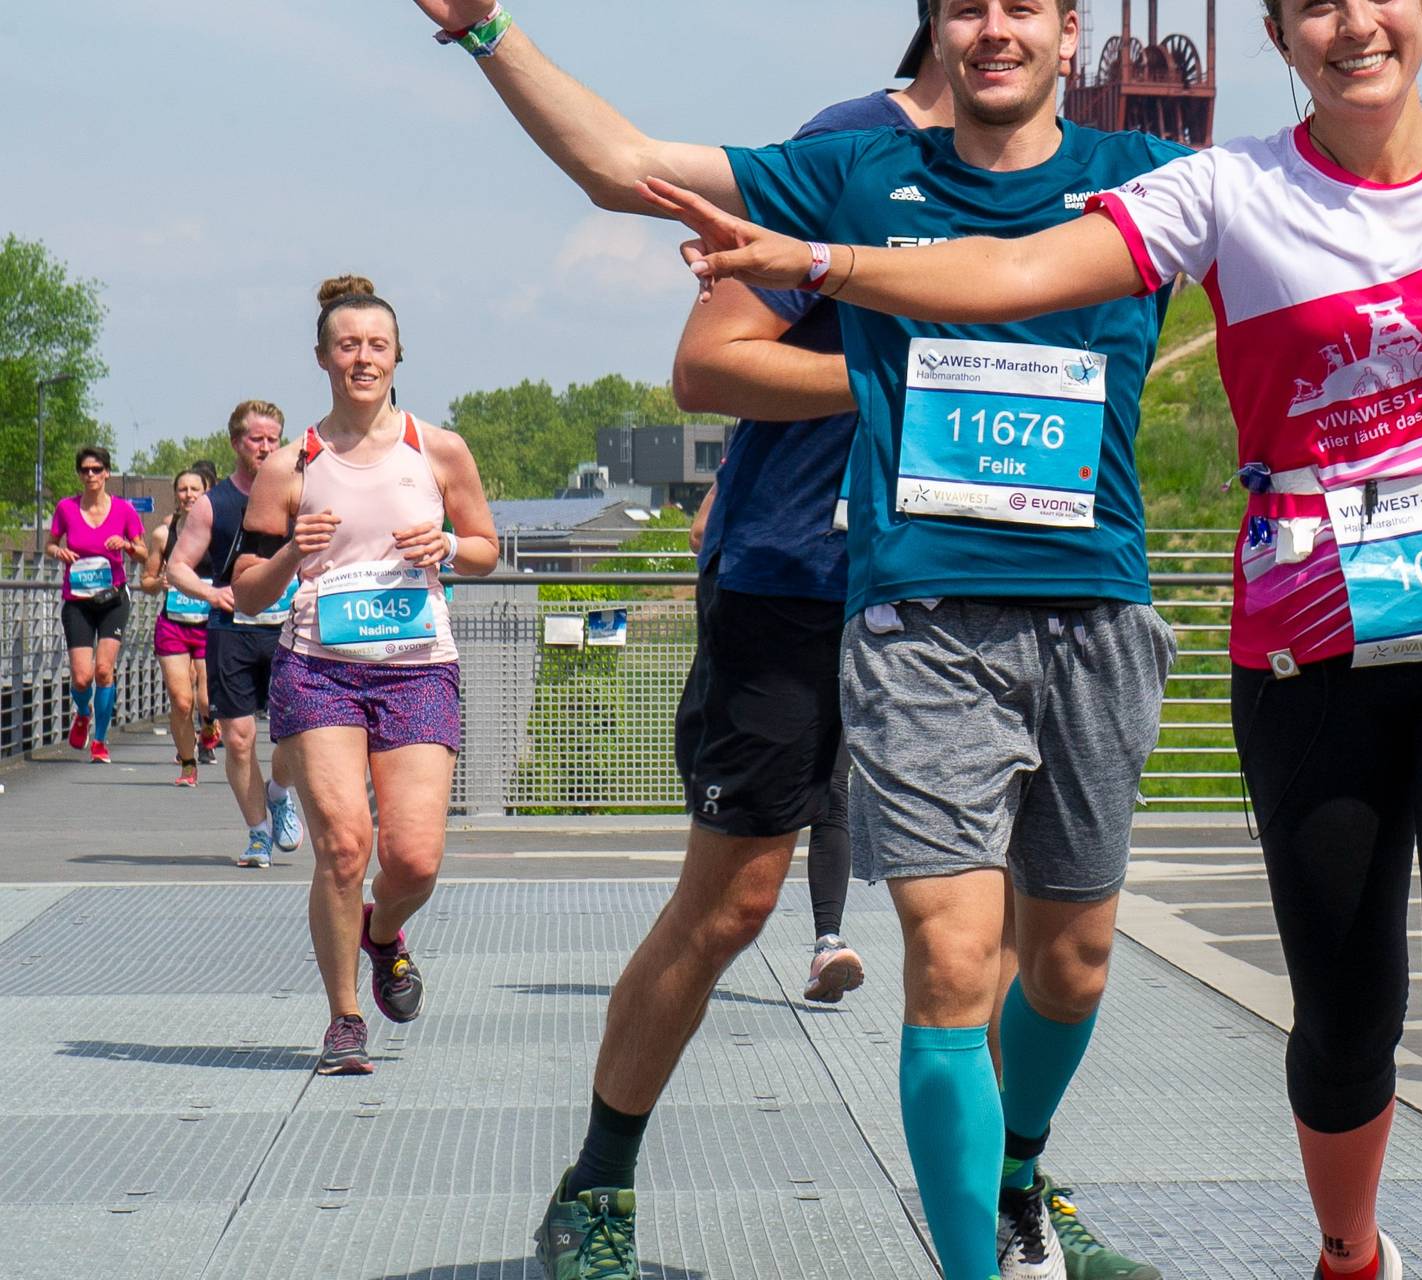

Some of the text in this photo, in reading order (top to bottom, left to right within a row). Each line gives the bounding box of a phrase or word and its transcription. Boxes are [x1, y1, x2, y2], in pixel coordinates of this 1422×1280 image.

[918, 354, 1058, 375] VAWEST-Marathon
[916, 370, 981, 382] Halbmarathon
[947, 408, 1065, 449] 11676
[1318, 435, 1350, 452] Hier
[1355, 422, 1391, 445] läuft
[979, 456, 1026, 475] Felix
[934, 490, 989, 504] VIVAWEST
[342, 598, 411, 620] 10045
[359, 624, 400, 636] Nadine
